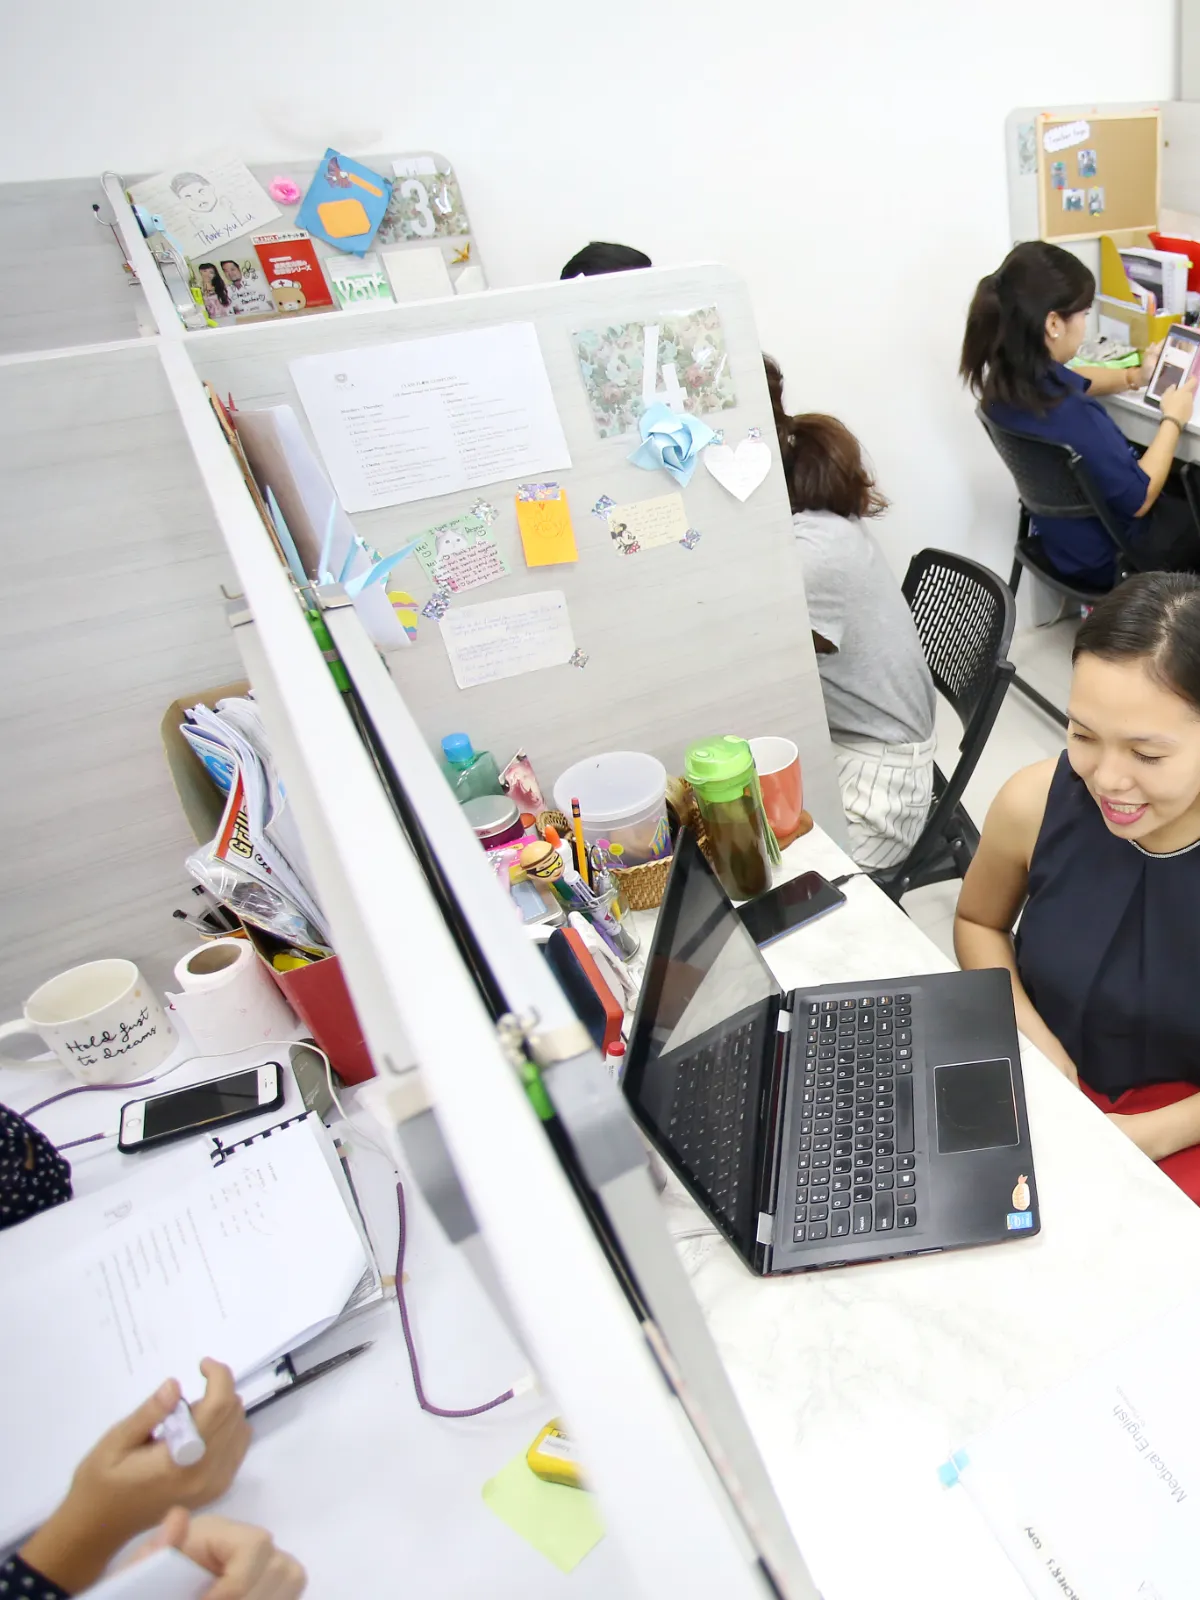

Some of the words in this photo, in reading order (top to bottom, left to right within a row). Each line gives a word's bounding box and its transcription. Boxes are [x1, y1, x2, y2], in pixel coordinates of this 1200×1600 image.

[401, 179, 435, 236] 3
[195, 225, 223, 246] Thank
[224, 222, 238, 237] you
[642, 325, 688, 415] 4
[66, 1031, 117, 1053] Hold
[77, 1054, 98, 1067] to
[104, 1025, 157, 1060] dreams
[1112, 1404, 1150, 1453] English
[1143, 1450, 1188, 1503] Medical
